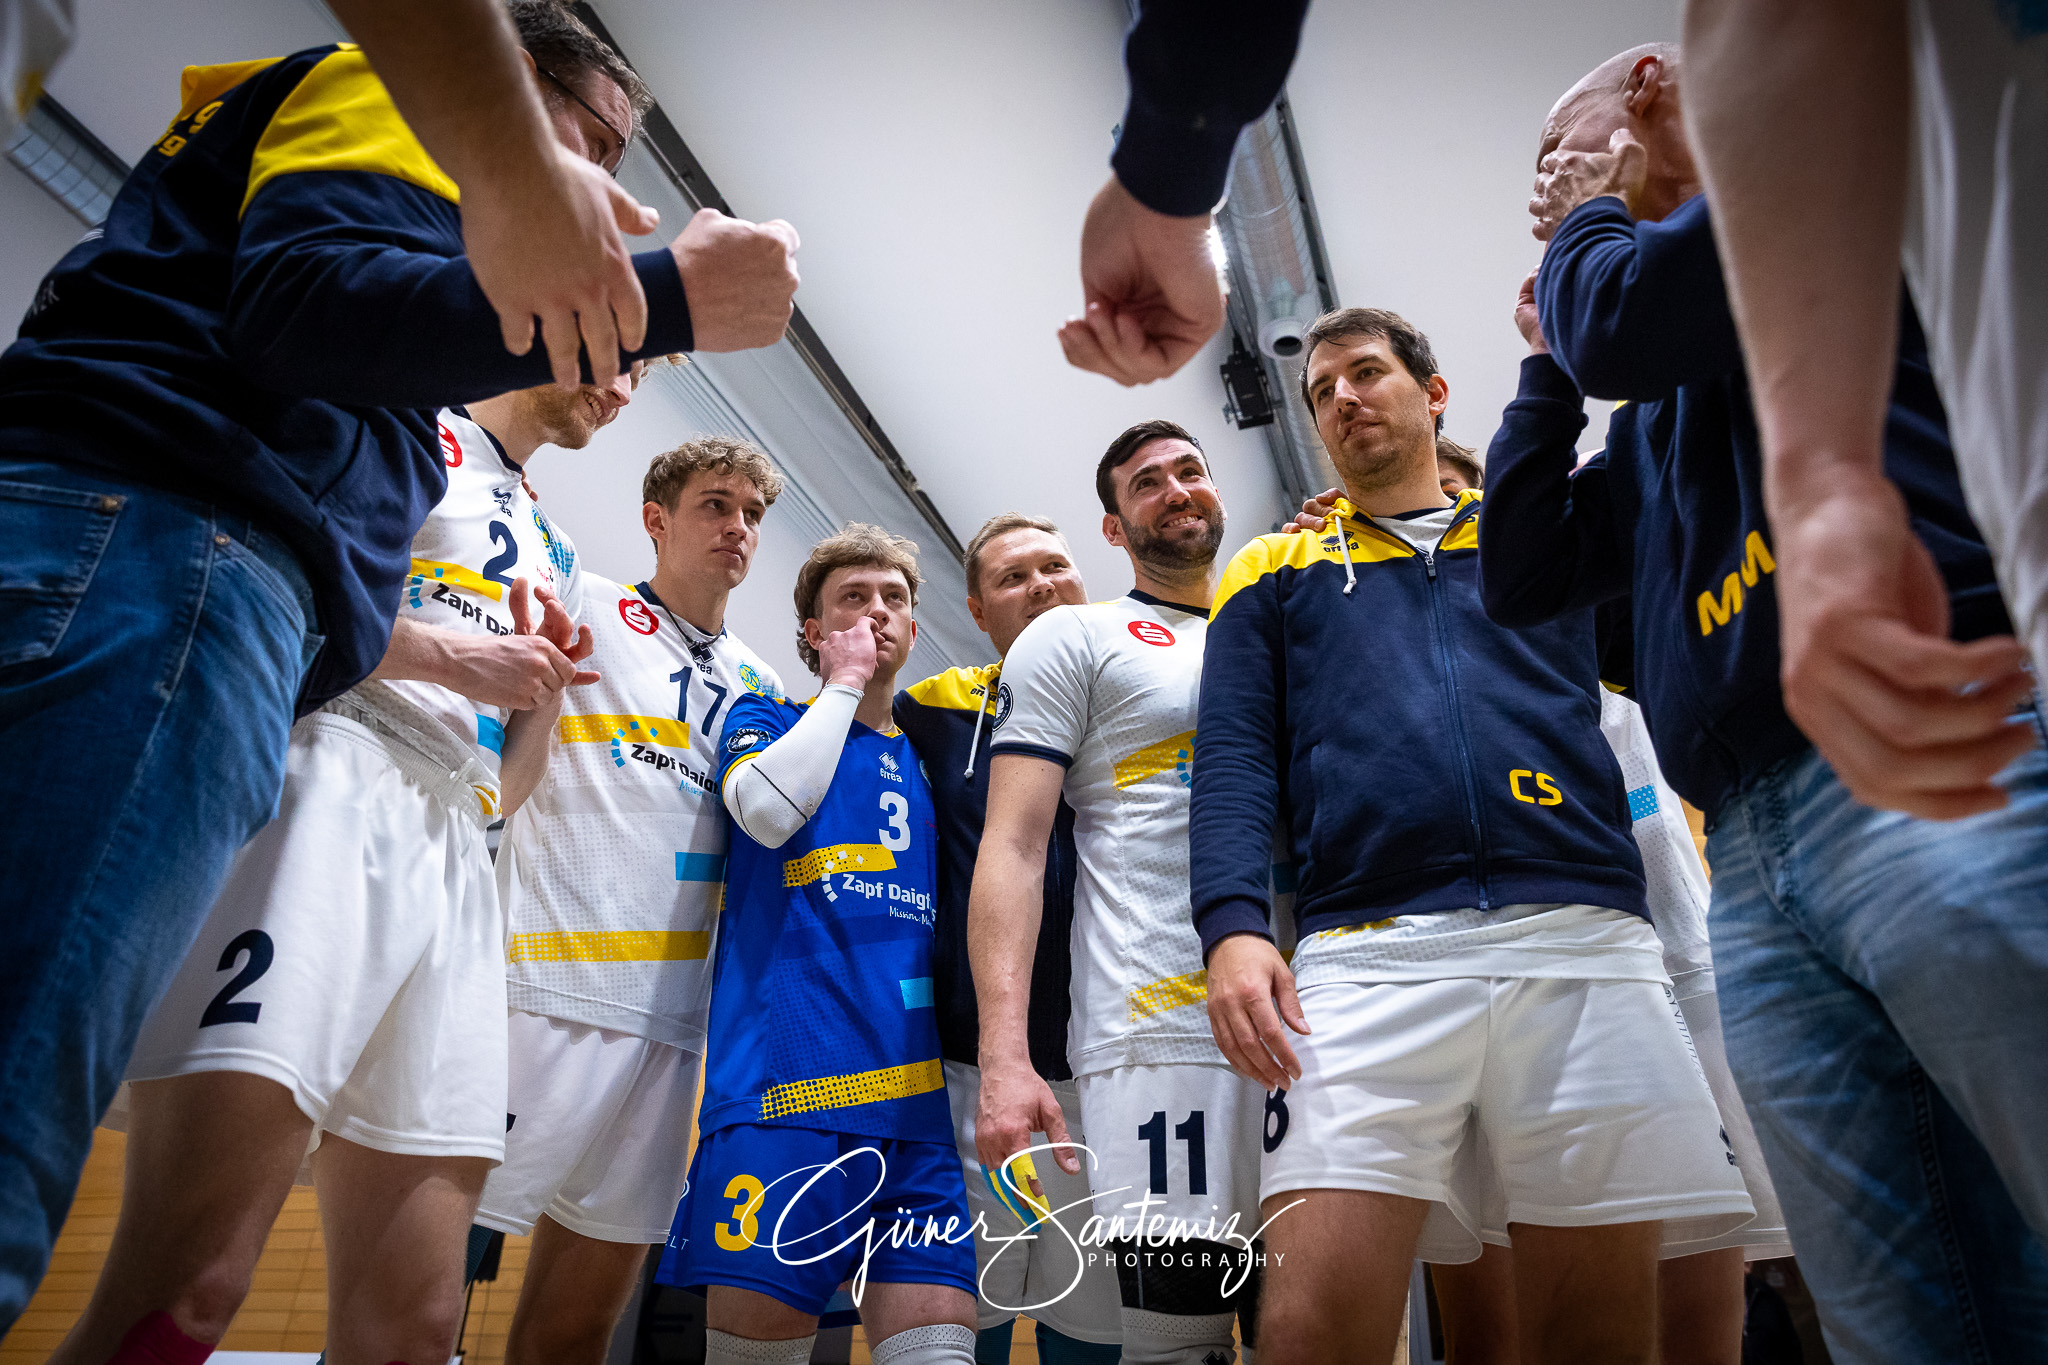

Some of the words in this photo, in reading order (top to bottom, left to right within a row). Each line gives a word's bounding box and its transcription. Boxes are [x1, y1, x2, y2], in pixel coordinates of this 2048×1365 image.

[483, 520, 518, 588] 2
[431, 582, 482, 624] Zapf
[669, 665, 728, 738] 17
[631, 743, 676, 771] Zapf
[1509, 768, 1563, 806] CS
[879, 790, 911, 852] 3
[842, 873, 884, 900] Zapf
[199, 928, 275, 1029] 2
[1137, 1110, 1208, 1195] 11
[714, 1173, 766, 1252] 3
